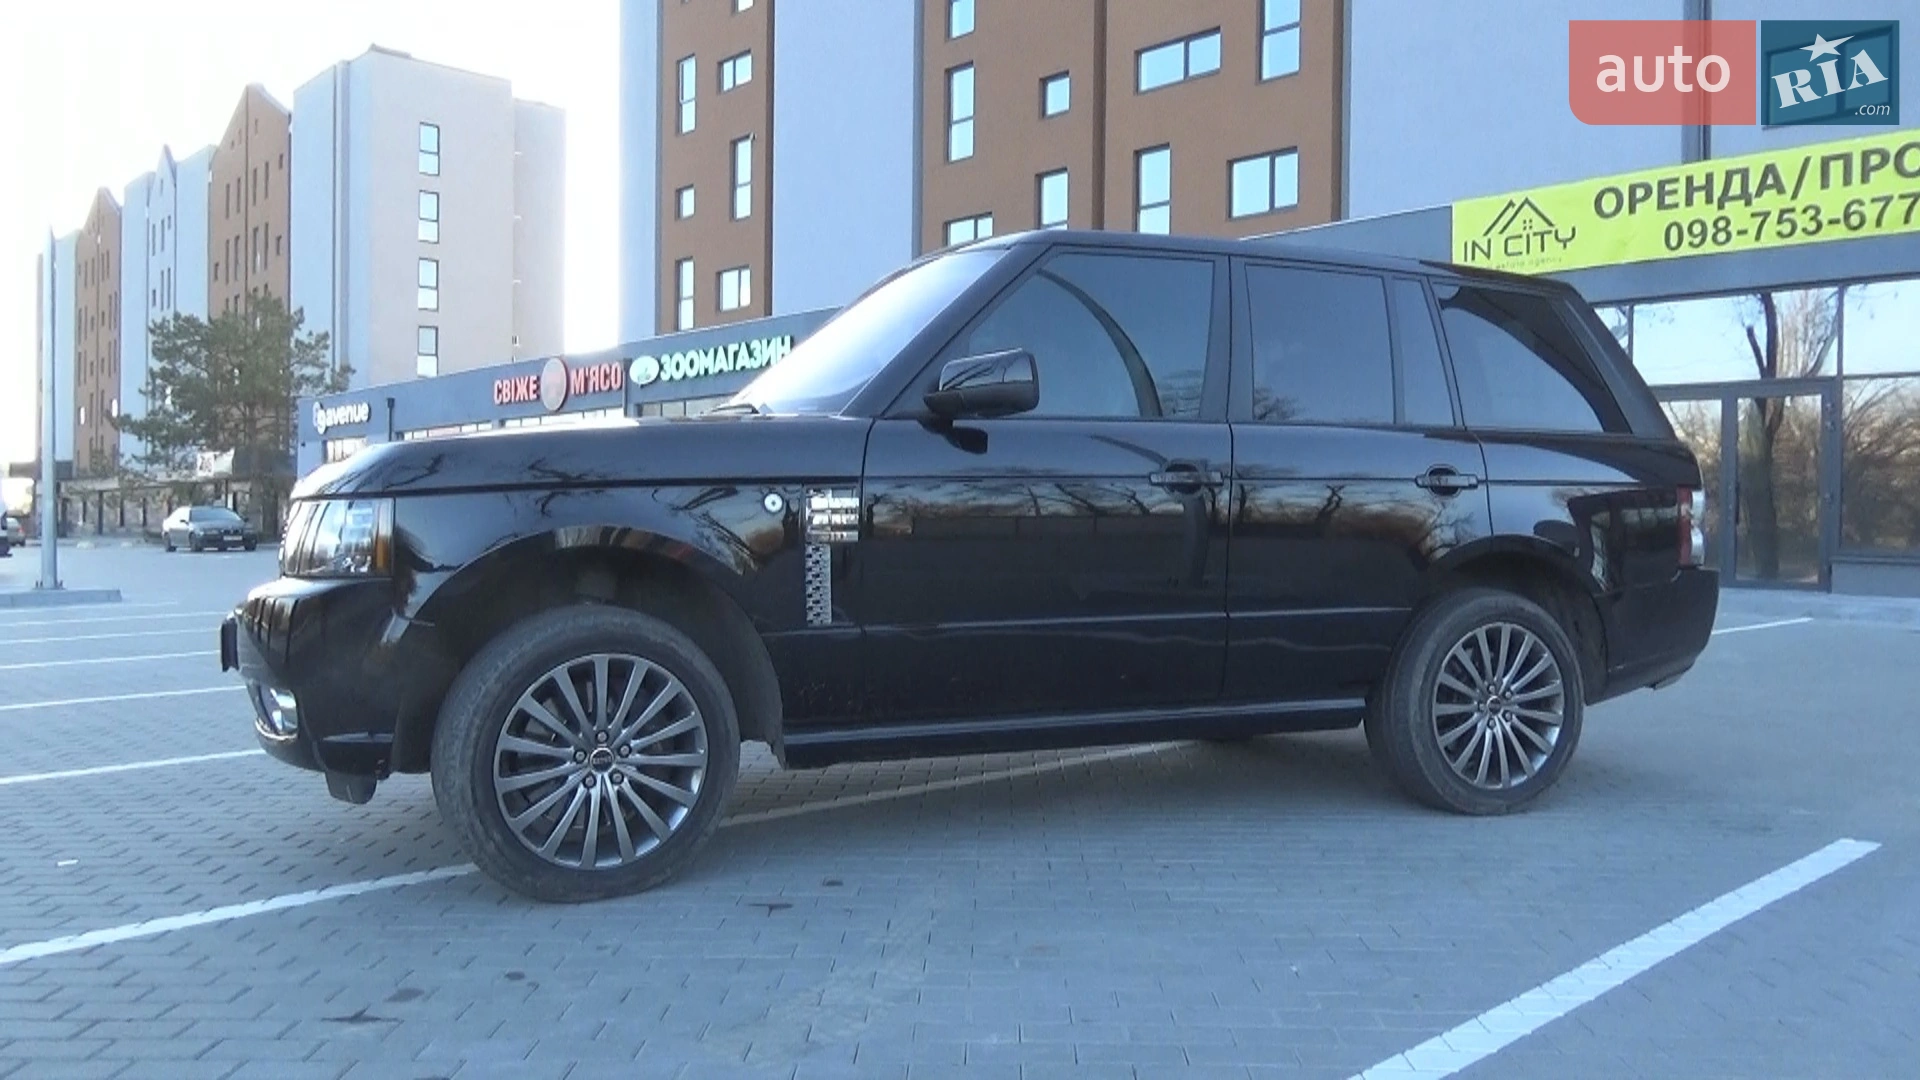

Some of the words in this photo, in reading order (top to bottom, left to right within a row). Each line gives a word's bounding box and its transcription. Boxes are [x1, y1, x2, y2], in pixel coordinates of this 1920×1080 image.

[1663, 191, 1920, 251] 098-753-677
[1463, 237, 1492, 262] IN
[1504, 226, 1576, 257] CITY
[659, 335, 791, 381] ЗООМАГАЗИН
[493, 375, 538, 405] СВІЖЕ
[570, 361, 622, 395] М'ЯСО
